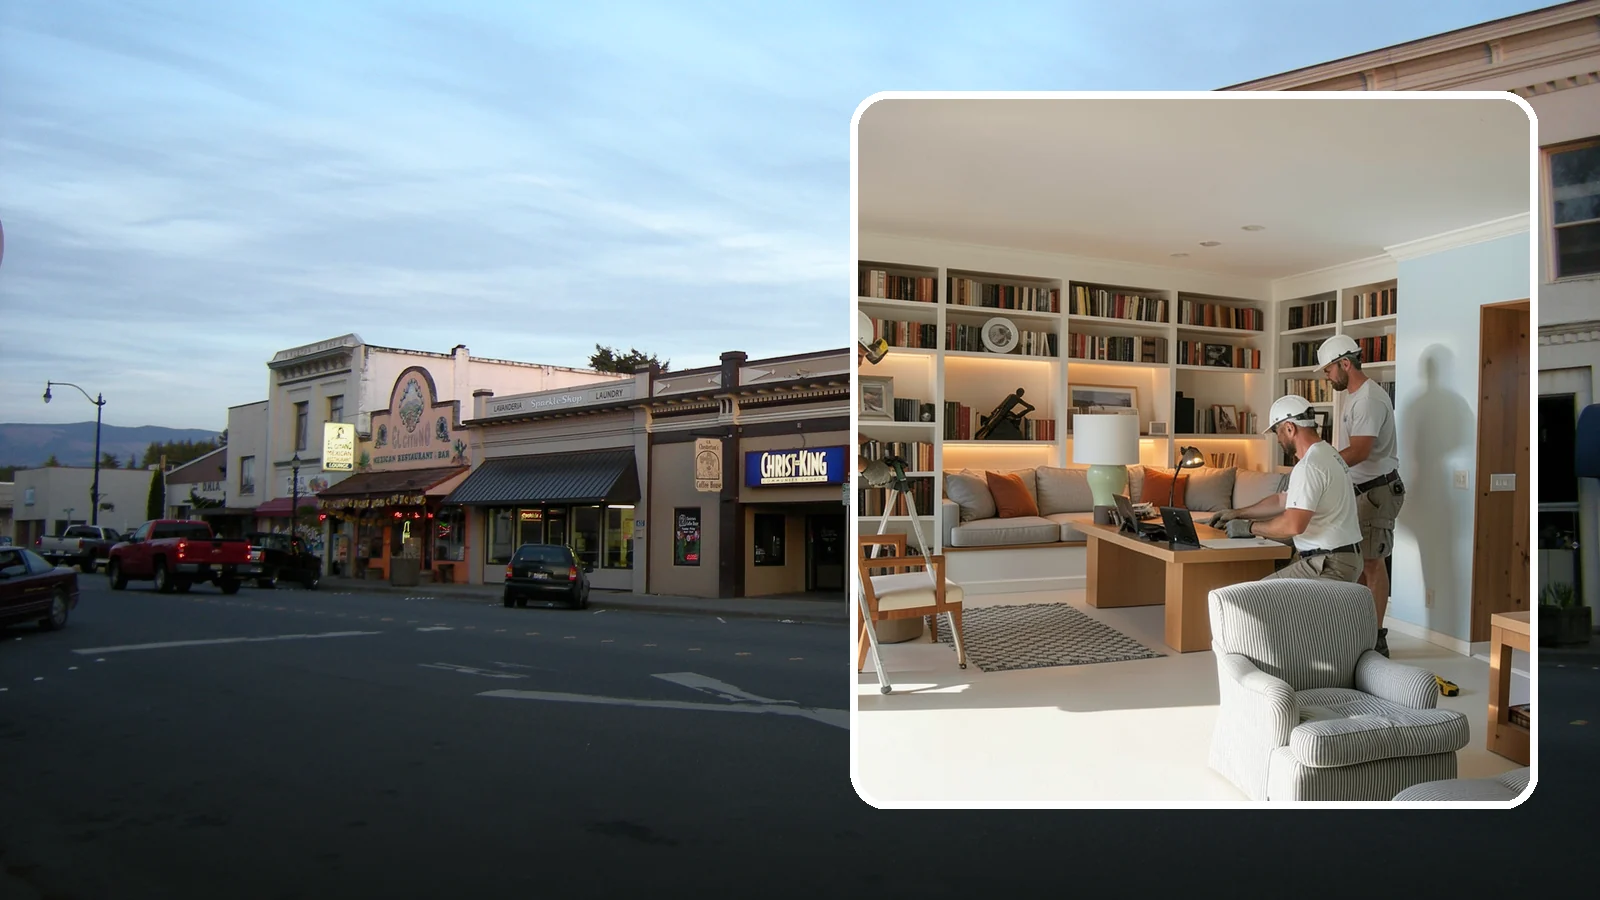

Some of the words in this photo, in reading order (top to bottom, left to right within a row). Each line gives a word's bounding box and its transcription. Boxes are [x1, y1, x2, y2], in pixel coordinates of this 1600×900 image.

[596, 388, 624, 400] LAUNDRY
[493, 402, 523, 413] LAVANDERIA
[530, 395, 562, 410] Sparkle
[562, 394, 583, 407] Shop
[374, 455, 397, 464] MEXICAN
[397, 451, 434, 462] RESTAURANT
[438, 450, 450, 459] BAR
[761, 452, 798, 478] CHRIST
[799, 450, 828, 477] KING
